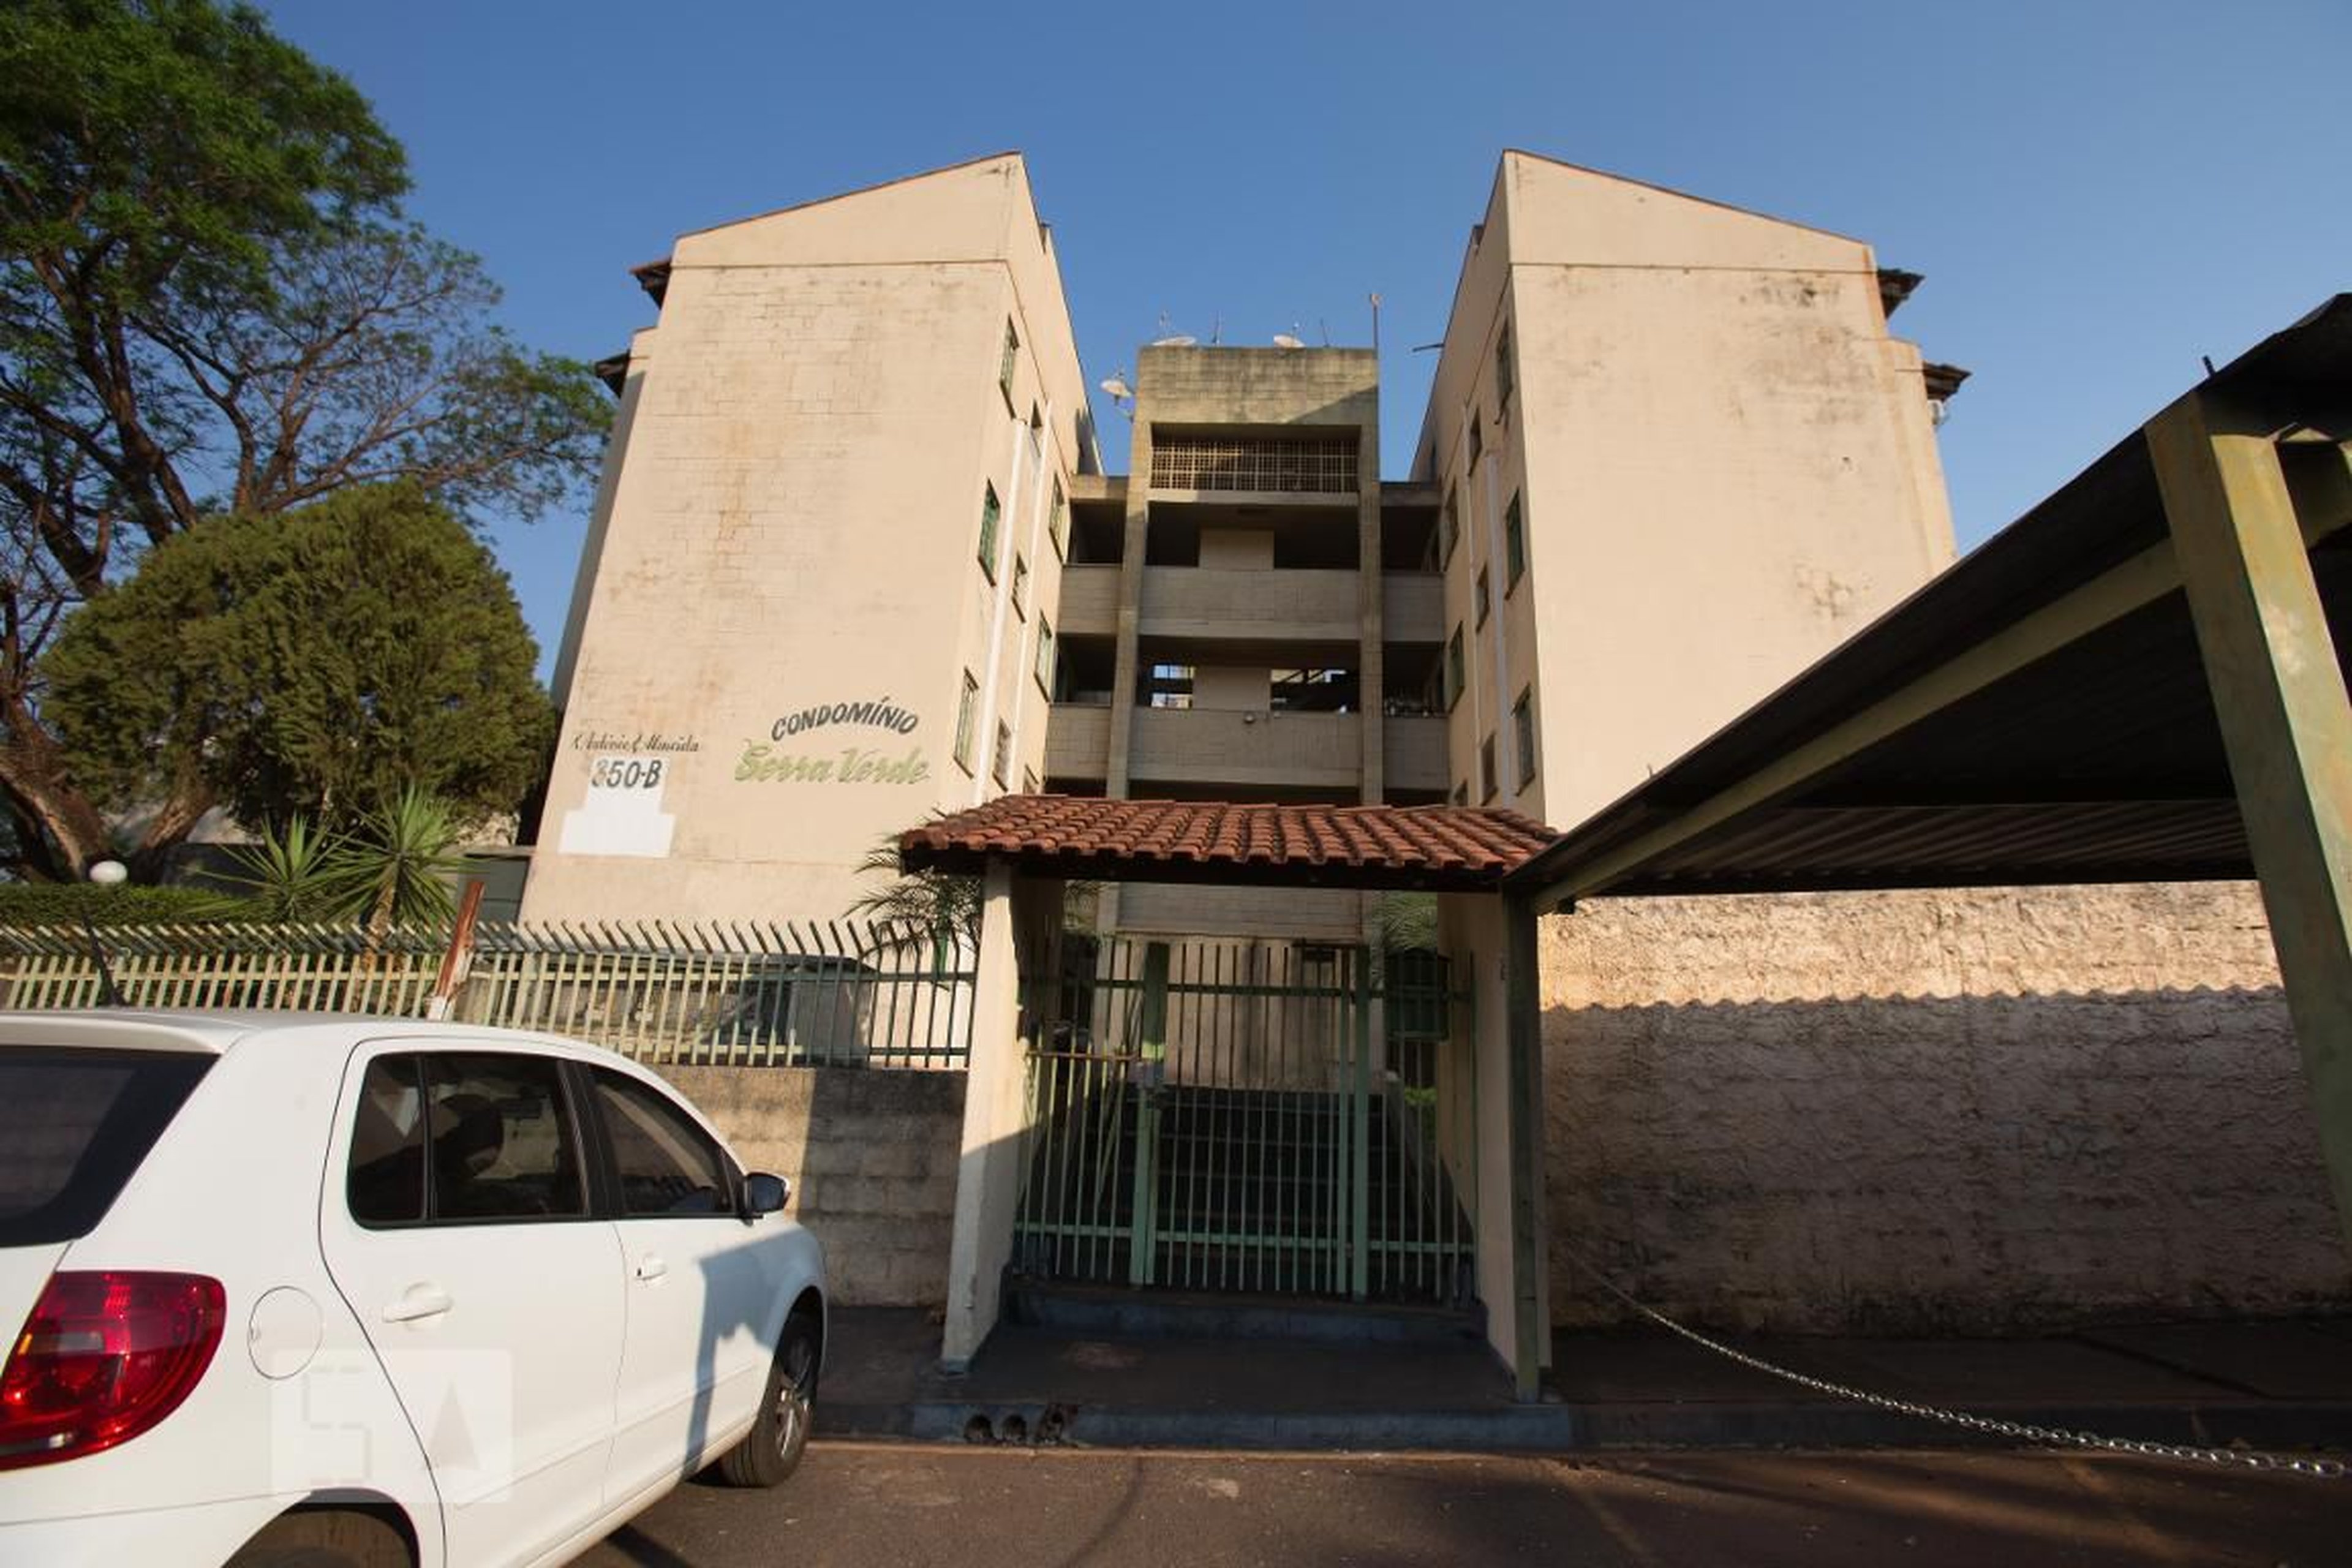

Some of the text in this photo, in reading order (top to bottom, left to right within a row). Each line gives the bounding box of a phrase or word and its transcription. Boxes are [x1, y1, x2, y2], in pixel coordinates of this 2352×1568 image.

[771, 696, 918, 741] CONDOMÍNIO
[734, 738, 931, 785] Serra Verde
